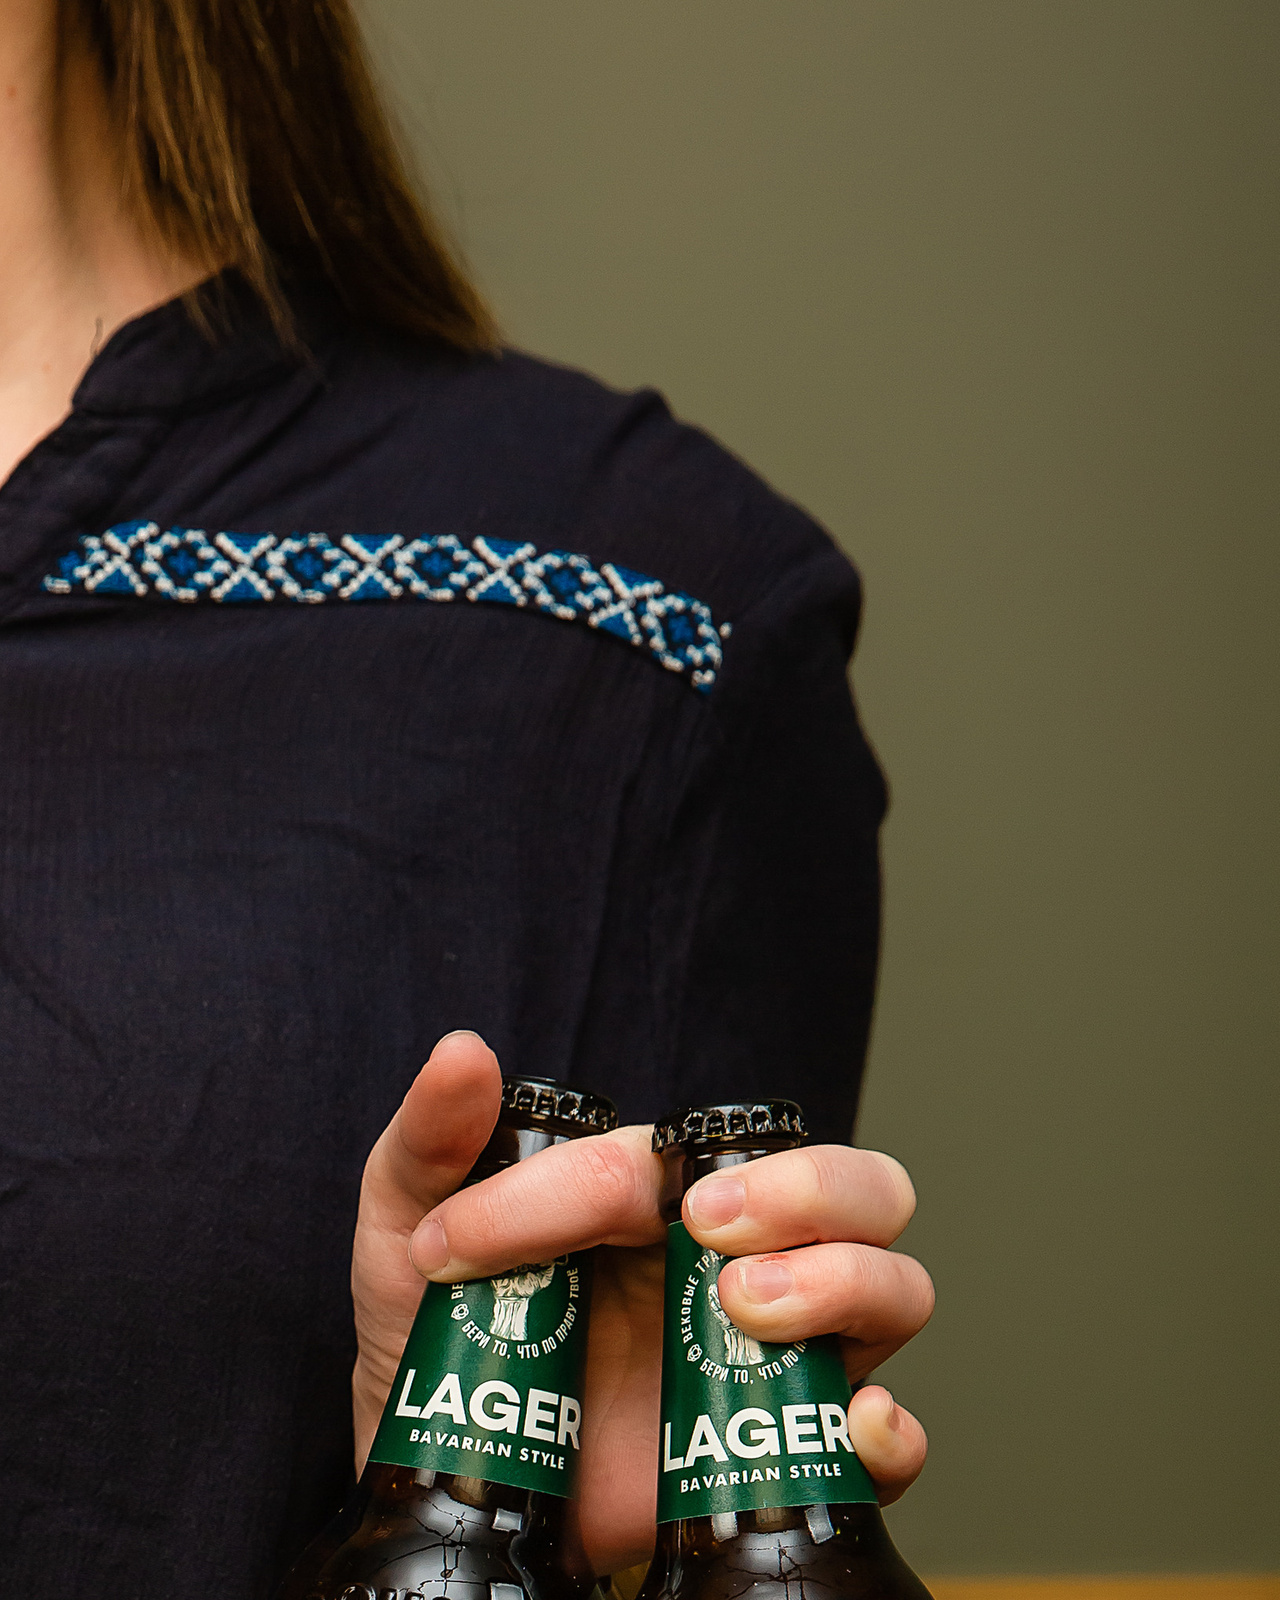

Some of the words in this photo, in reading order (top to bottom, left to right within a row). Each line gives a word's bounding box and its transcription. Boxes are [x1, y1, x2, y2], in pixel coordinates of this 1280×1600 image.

[461, 1320, 491, 1349] БЕРИ
[492, 1340, 511, 1359] ТО,
[516, 1343, 540, 1359] ЧТО
[541, 1336, 558, 1354] ПО
[555, 1302, 578, 1342] ПРАВУ
[681, 1274, 699, 1344] ВЕКОВЫЕ
[699, 1358, 729, 1382] БЕРИ
[734, 1369, 754, 1385] ТО,
[757, 1361, 783, 1380] ЧТО
[781, 1350, 799, 1369] ПО
[395, 1368, 582, 1450] LAGER
[409, 1428, 512, 1458] BAVARIAN
[519, 1448, 565, 1470] STYLE
[663, 1403, 855, 1473] LAGER
[680, 1466, 780, 1494] BAVARIAN
[789, 1463, 842, 1479] STYLE
